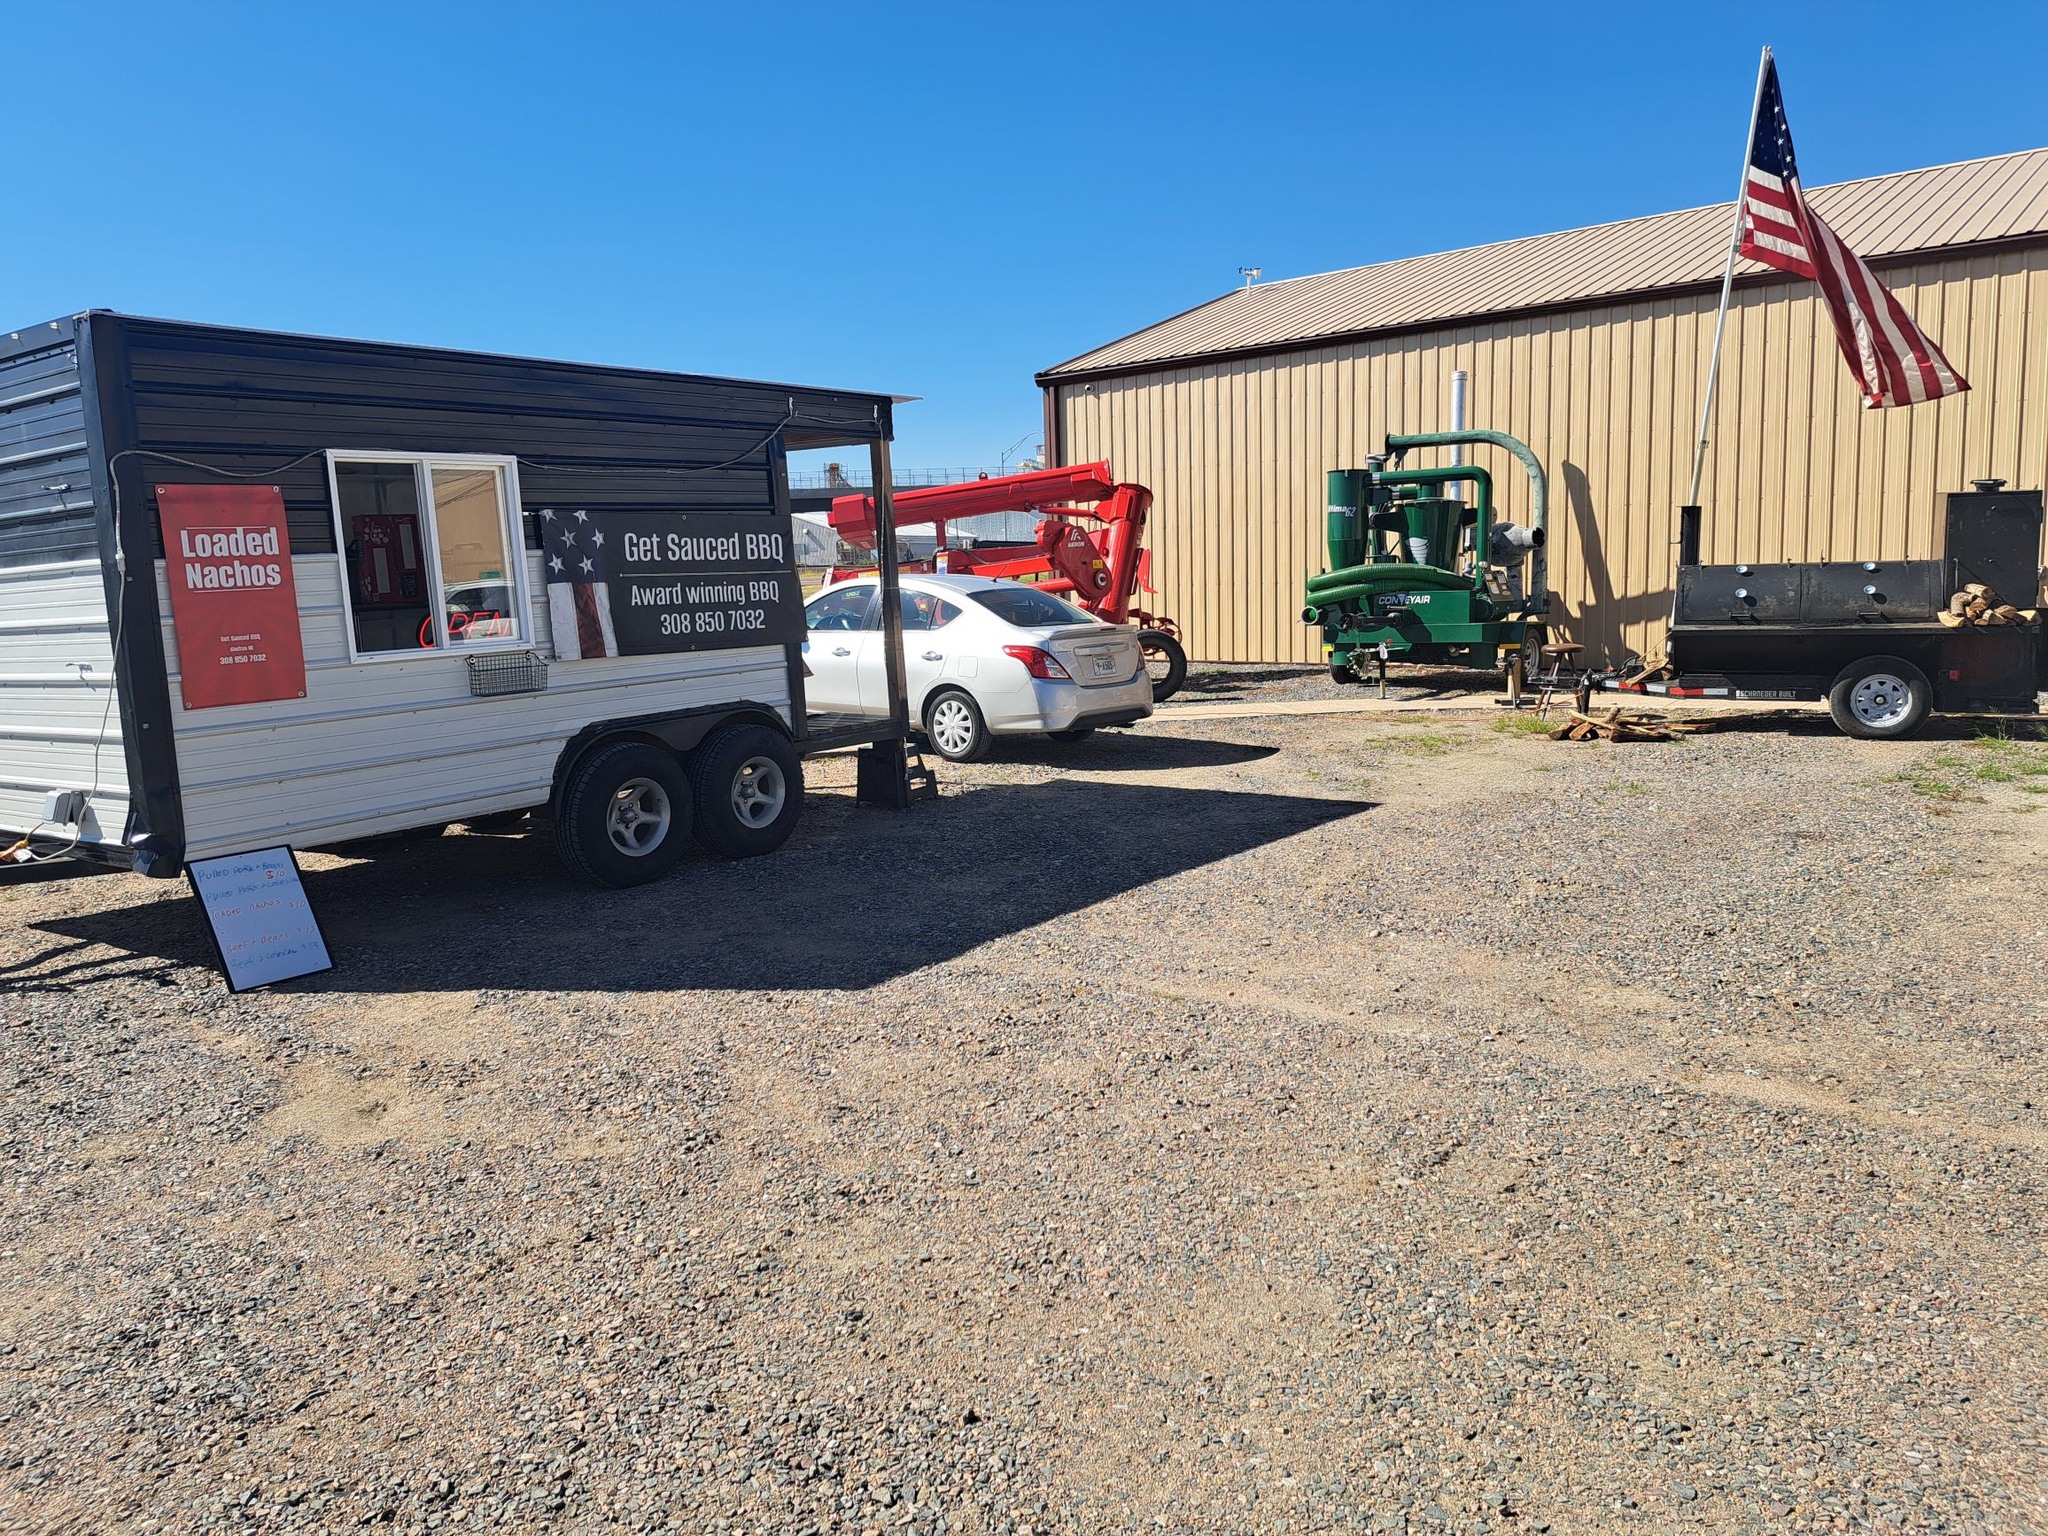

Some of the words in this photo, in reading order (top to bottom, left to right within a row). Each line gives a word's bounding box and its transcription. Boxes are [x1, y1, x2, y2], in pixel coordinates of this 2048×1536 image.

[180, 526, 280, 558] Loaded
[624, 532, 662, 562] Get
[667, 532, 740, 562] Sauced
[745, 533, 784, 564] BBQ
[185, 560, 282, 589] Nachos
[631, 582, 682, 607] Award
[686, 581, 745, 606] winning
[749, 580, 780, 604] BBQ
[1378, 593, 1431, 606] CONVEYAIR
[660, 612, 691, 635] 308
[695, 611, 725, 633] 850
[728, 609, 766, 631] 7032
[219, 656, 234, 665] 308
[234, 655, 248, 664] 850
[249, 653, 267, 662] 7032
[1740, 690, 1777, 698] SCHROEDER
[1778, 690, 1797, 698] BUILT
